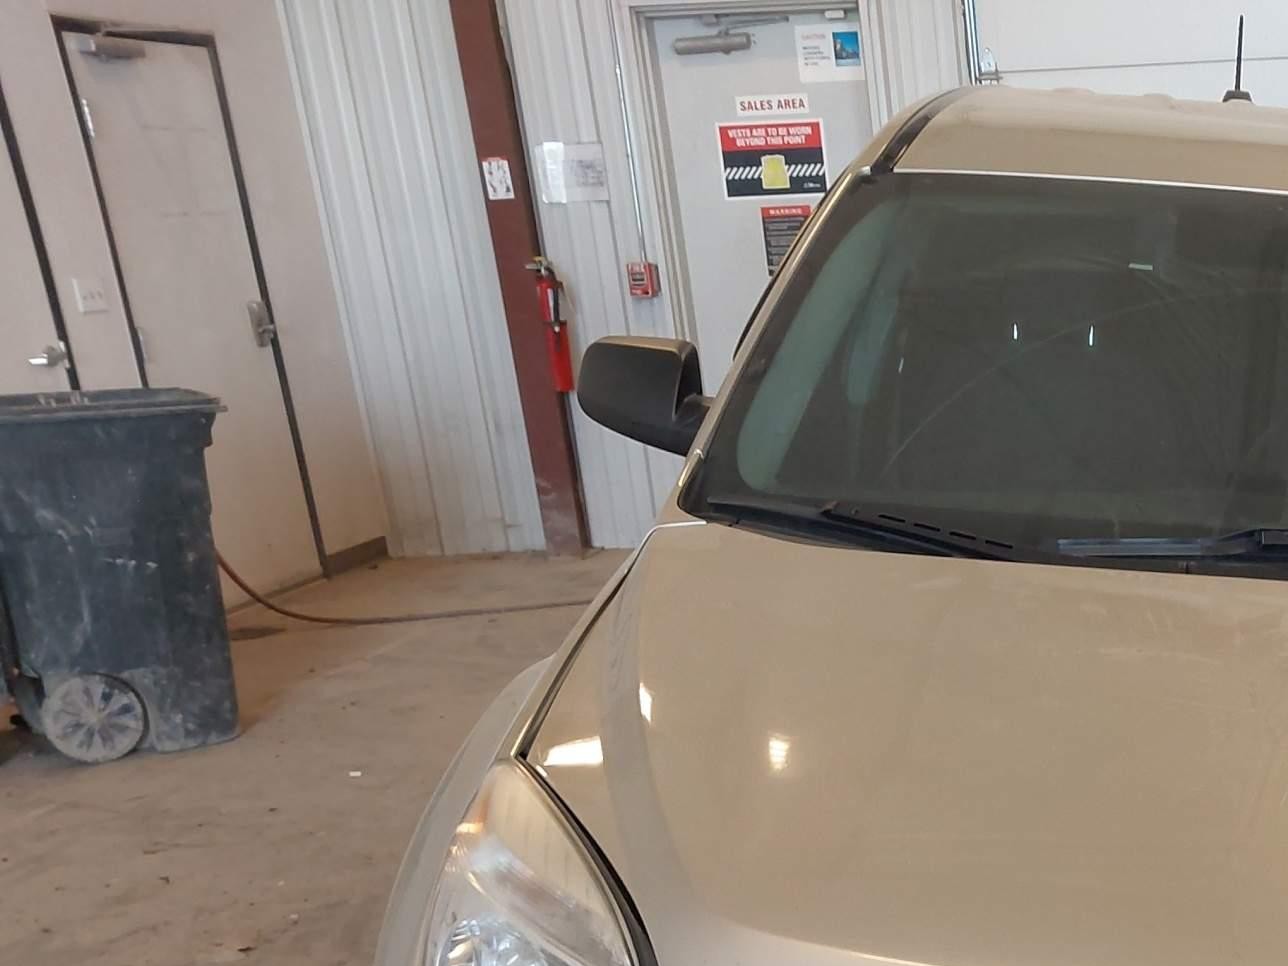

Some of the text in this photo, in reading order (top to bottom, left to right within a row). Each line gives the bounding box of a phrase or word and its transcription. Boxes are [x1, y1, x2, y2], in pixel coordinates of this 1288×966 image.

[739, 98, 806, 112] SALES AREA
[727, 128, 751, 138] VESTS
[752, 127, 766, 137] ARE
[767, 127, 777, 136] TO
[788, 125, 812, 135] WORN
[736, 134, 806, 147] BEYOND THIS POINT
